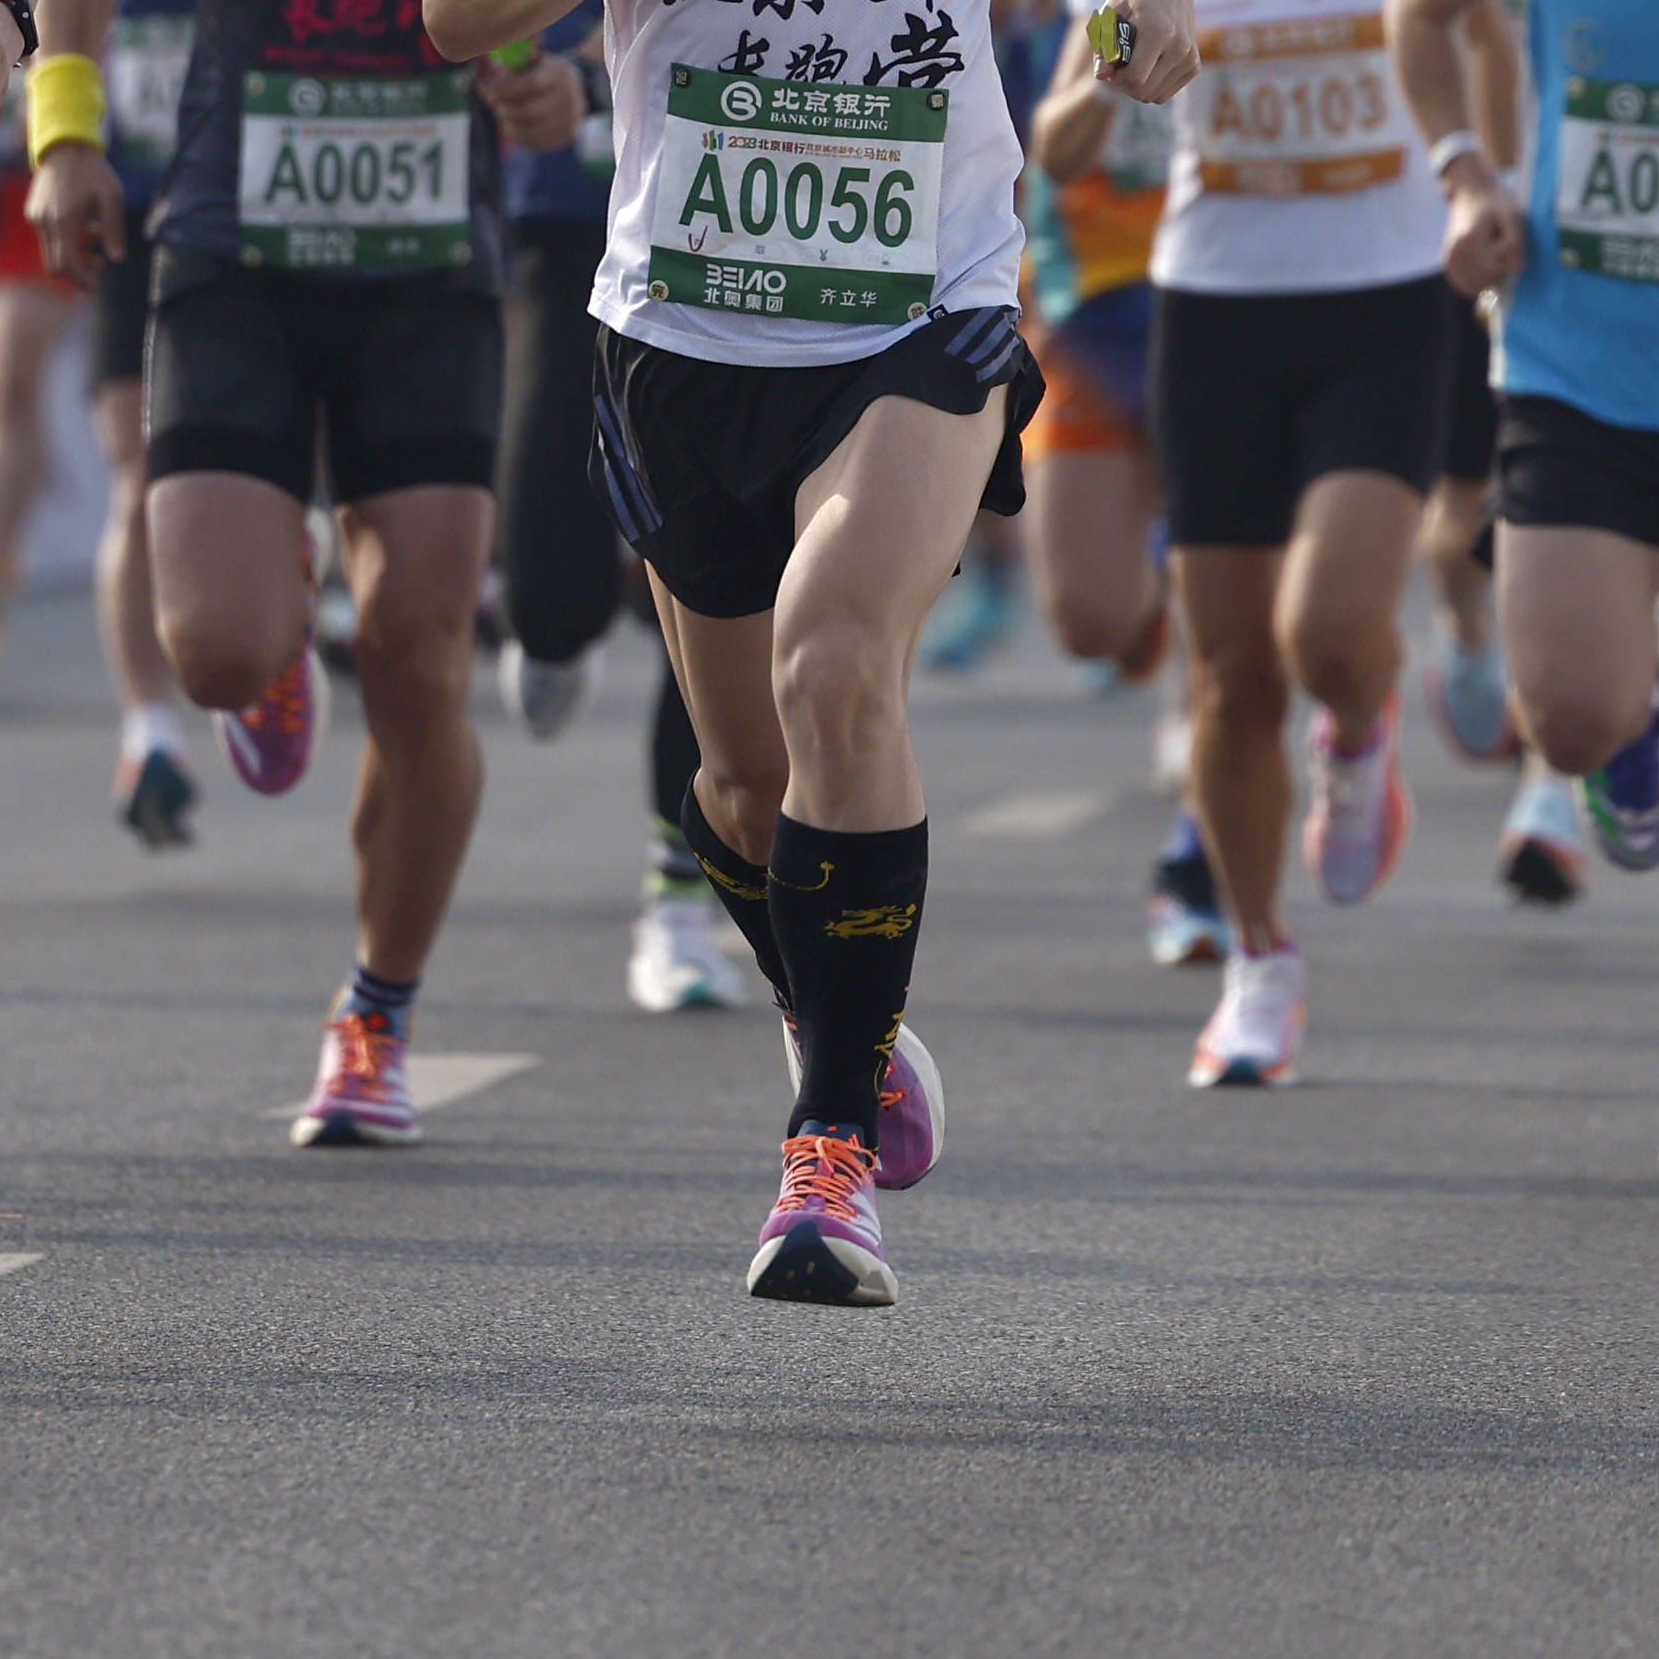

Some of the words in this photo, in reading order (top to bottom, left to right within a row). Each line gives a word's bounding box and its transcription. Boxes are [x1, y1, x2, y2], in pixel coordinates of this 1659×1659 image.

[772, 88, 891, 117] 北京银行
[1209, 74, 1389, 142] A0103
[770, 111, 808, 126] BANK
[812, 117, 831, 128] OF
[834, 118, 889, 131] BEIJING
[264, 141, 445, 206] A0051
[679, 152, 915, 247] A0056
[705, 263, 787, 294] BEIAO
[703, 287, 784, 312] 北奥集团
[820, 288, 878, 308] 齐立华
